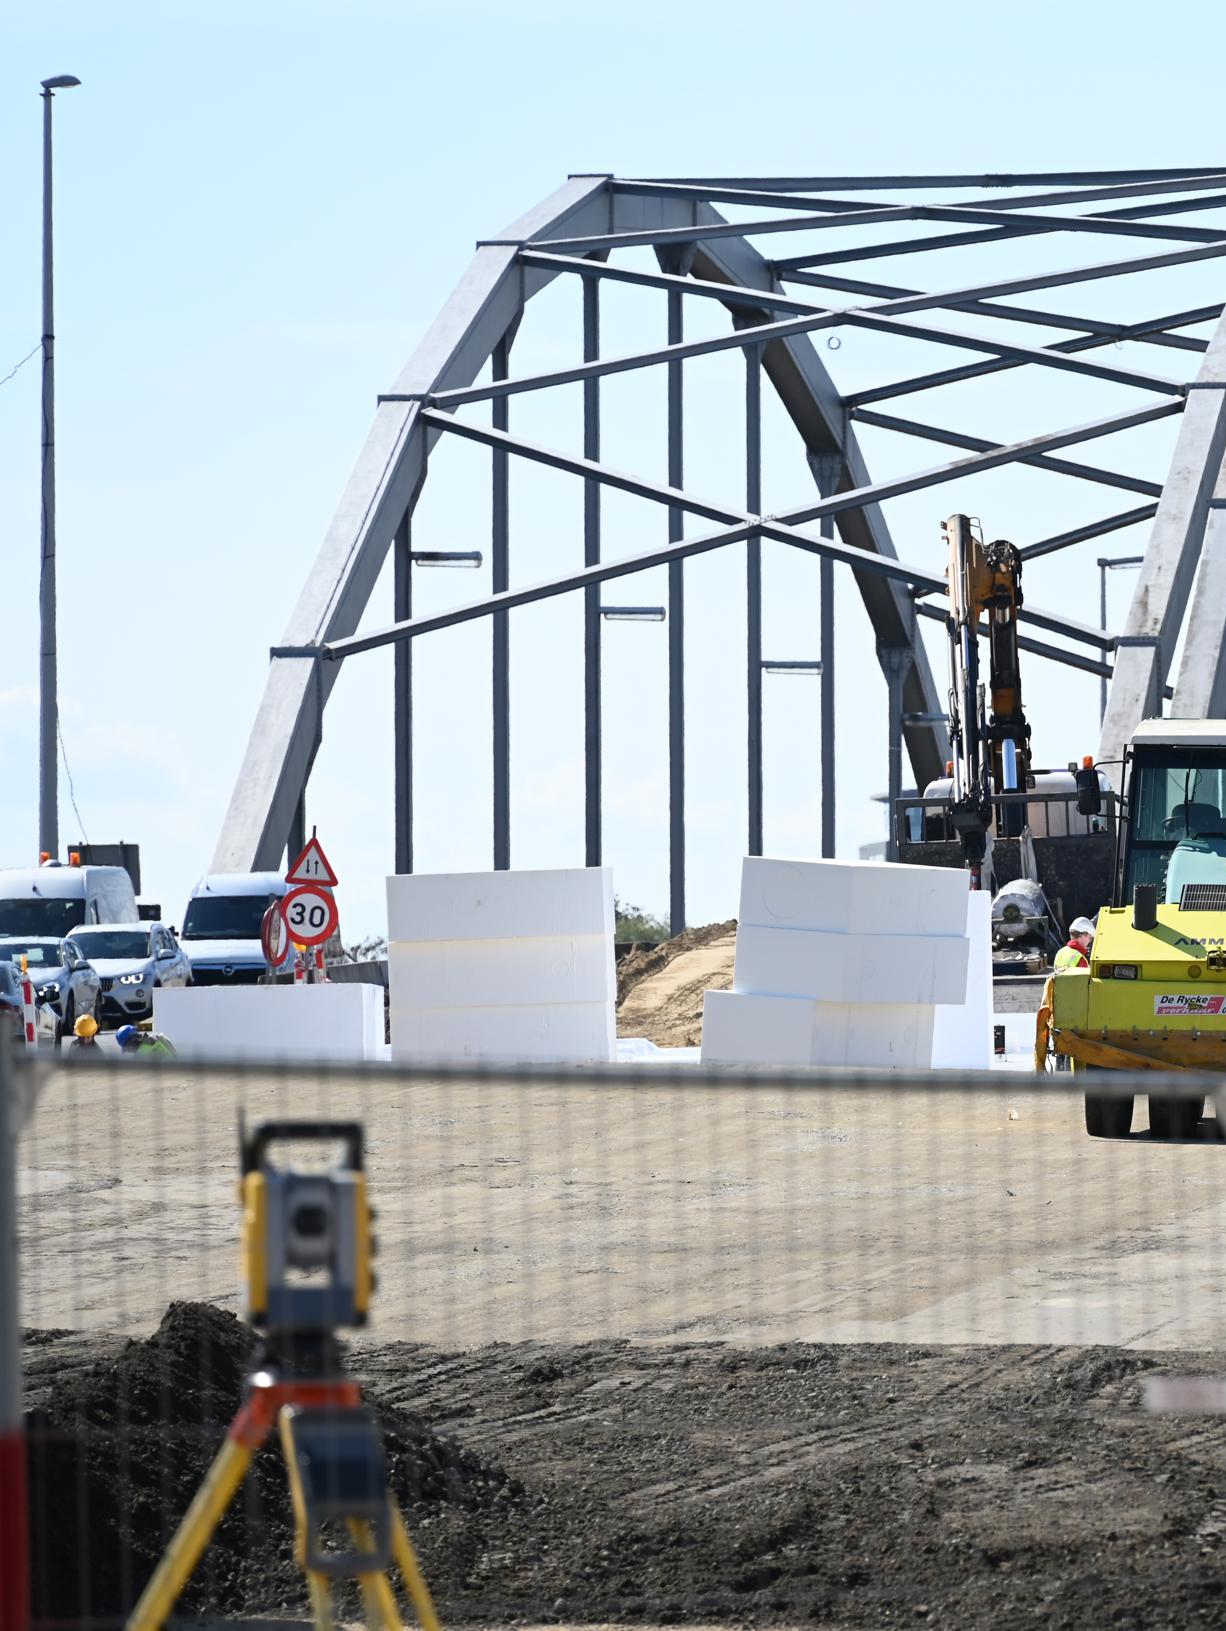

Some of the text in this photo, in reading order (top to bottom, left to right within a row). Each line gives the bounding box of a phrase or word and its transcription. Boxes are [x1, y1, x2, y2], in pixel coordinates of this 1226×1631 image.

[290, 902, 326, 929] 30
[1160, 995, 1209, 1006] De Rycke
